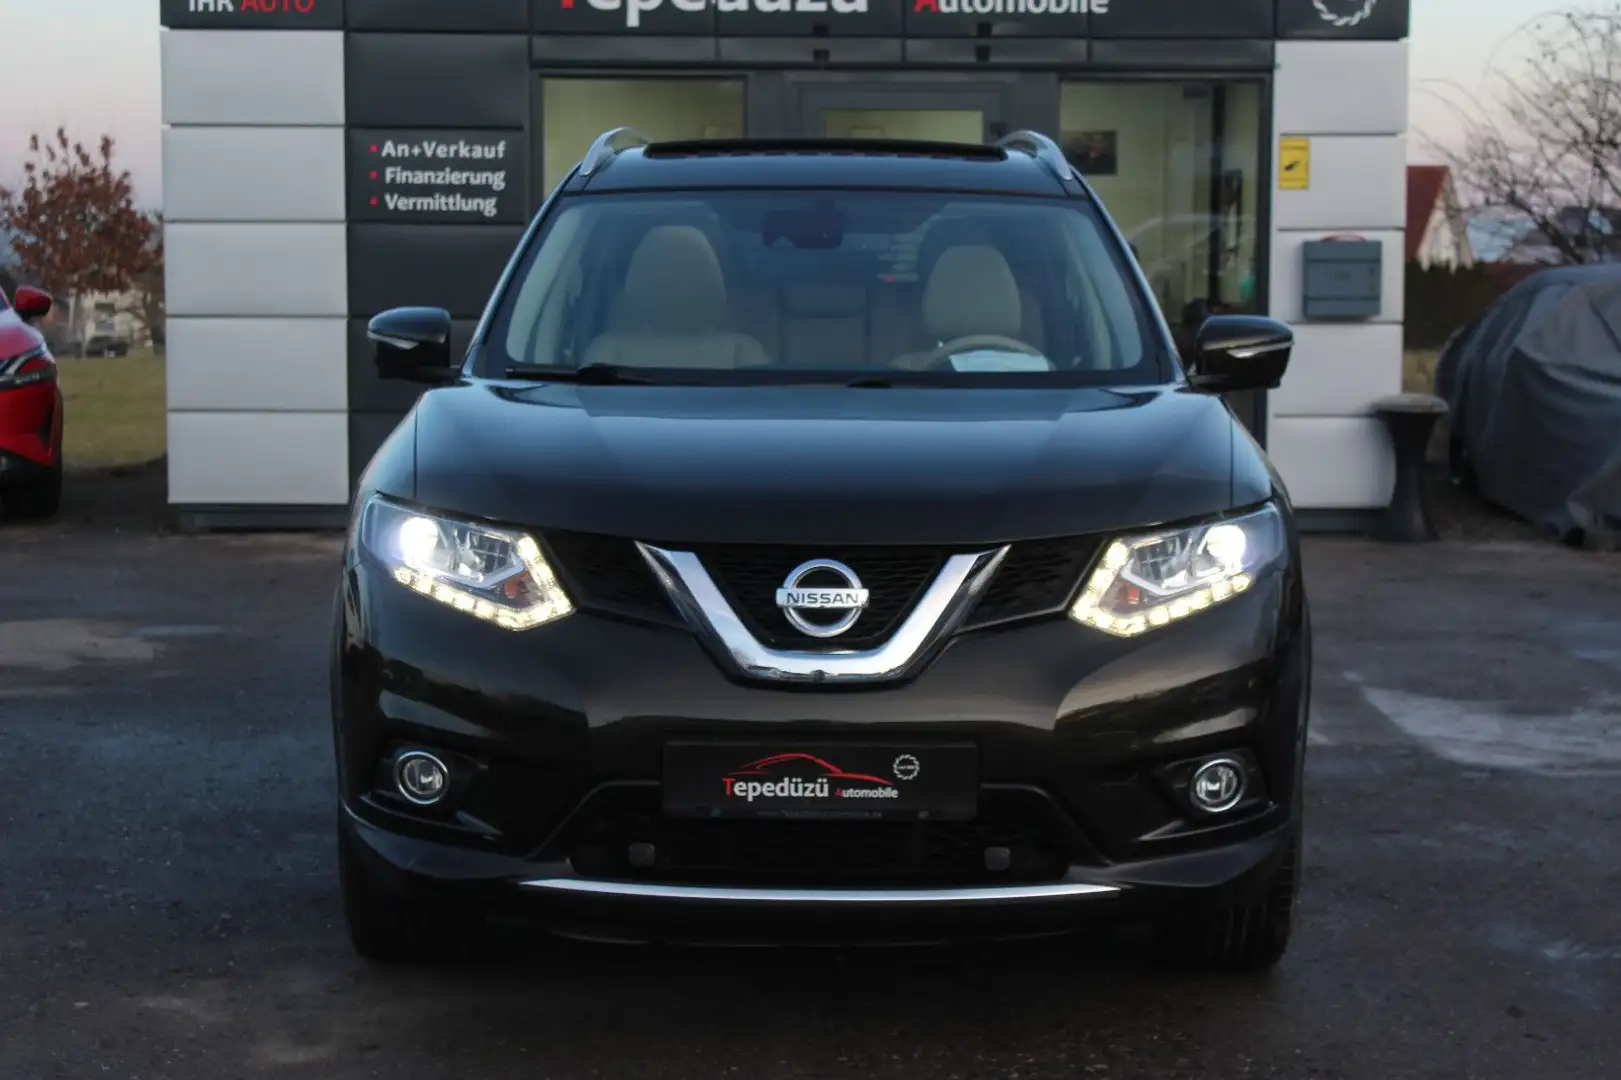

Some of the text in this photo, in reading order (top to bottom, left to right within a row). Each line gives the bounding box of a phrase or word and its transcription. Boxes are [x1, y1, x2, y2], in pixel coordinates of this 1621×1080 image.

[381, 139, 506, 159] An+Verkauf
[385, 166, 506, 191] Finanzierung
[384, 193, 498, 217] Vermittlung
[786, 592, 859, 605] NISSAN
[722, 777, 898, 802] Tepedüzü Automobile
